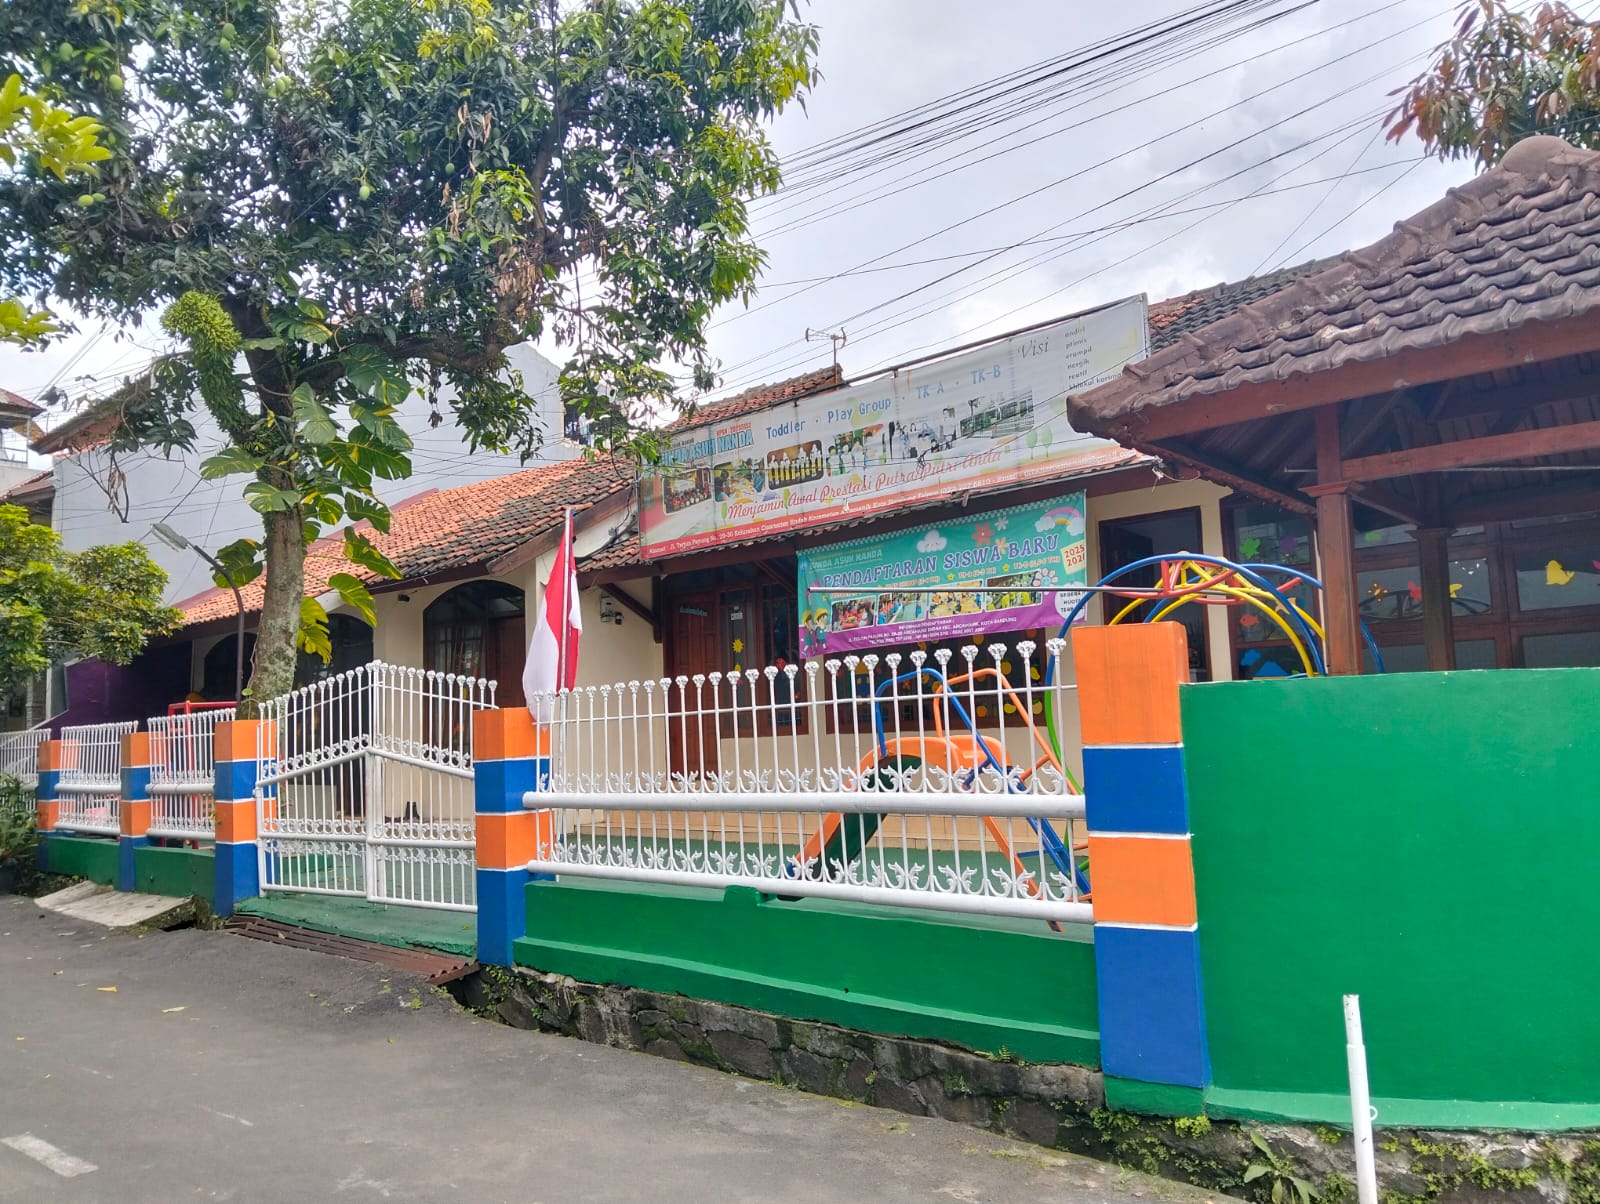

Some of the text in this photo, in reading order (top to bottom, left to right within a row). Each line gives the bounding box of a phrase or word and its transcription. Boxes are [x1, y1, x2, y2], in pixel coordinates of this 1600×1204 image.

[1017, 337, 1049, 359] Visi
[766, 420, 806, 440] Toddler
[828, 408, 853, 423] Play
[859, 398, 891, 415] Group
[689, 438, 716, 461] ASUH
[727, 497, 785, 519] Menjamin
[787, 487, 818, 507] Awal
[820, 474, 872, 503] Prestasi
[875, 470, 916, 491] Putra
[918, 460, 958, 481] Putri
[823, 556, 938, 587] PENDAFTARAN
[943, 545, 1001, 570] SISWA
[1008, 534, 1059, 559] BARU
[1064, 544, 1086, 559] 2025
